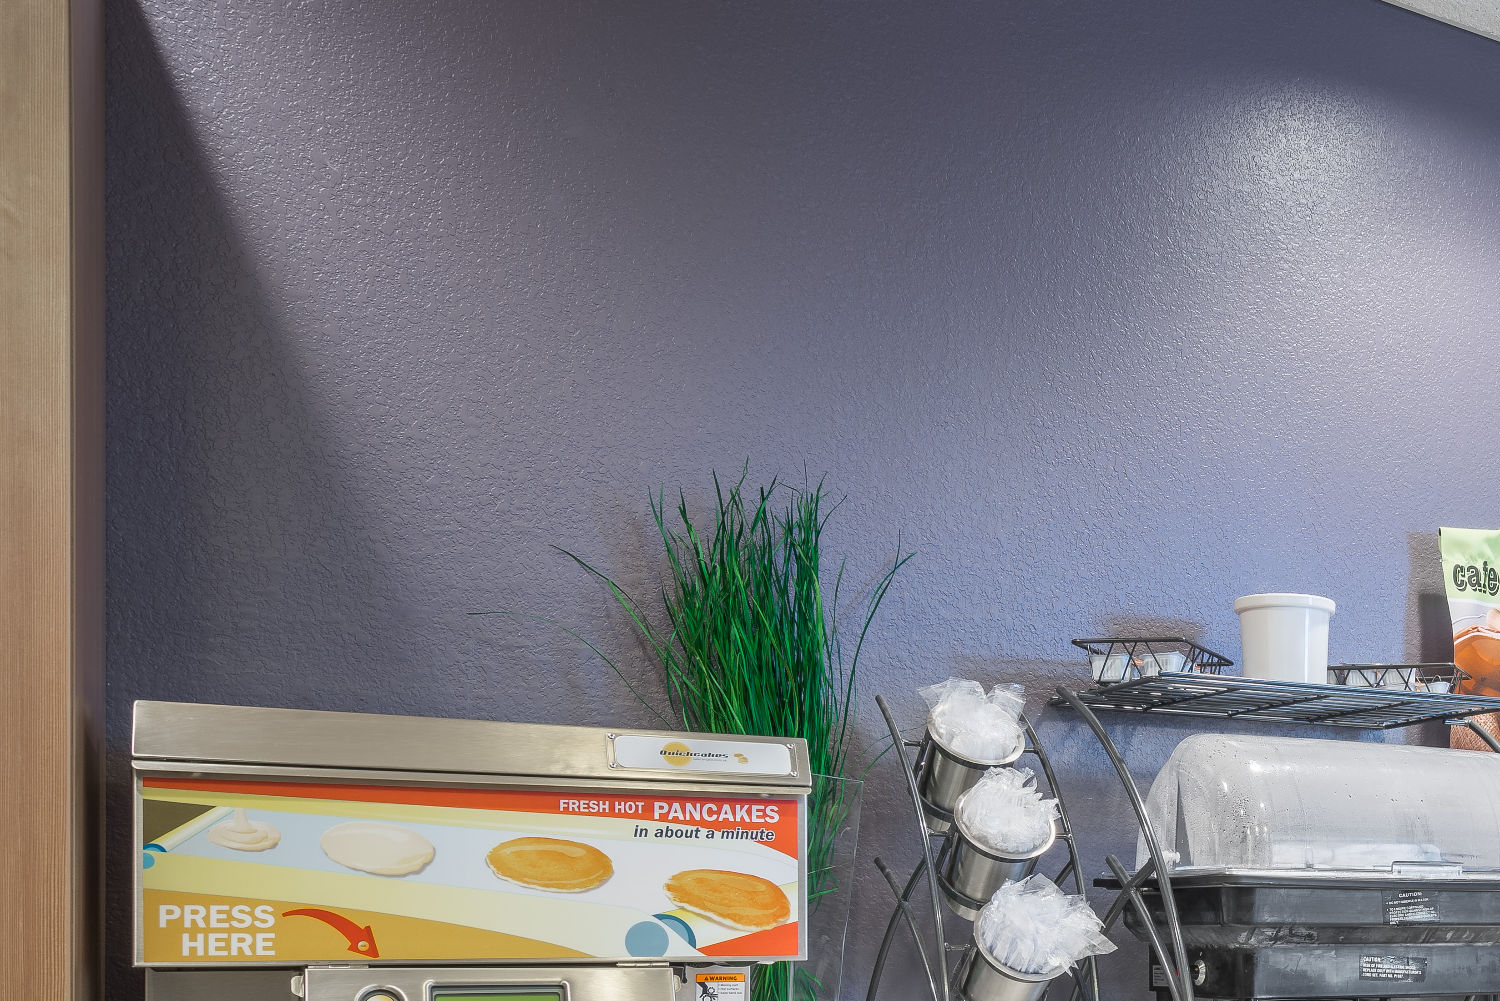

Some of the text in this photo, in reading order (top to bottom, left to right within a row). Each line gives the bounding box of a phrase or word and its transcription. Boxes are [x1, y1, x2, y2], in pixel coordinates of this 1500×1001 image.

[559, 799, 780, 824] FRESH HOT PANCAKES
[633, 825, 775, 841] in about a minute
[159, 904, 276, 929] PRESS
[182, 932, 276, 957] HERE
